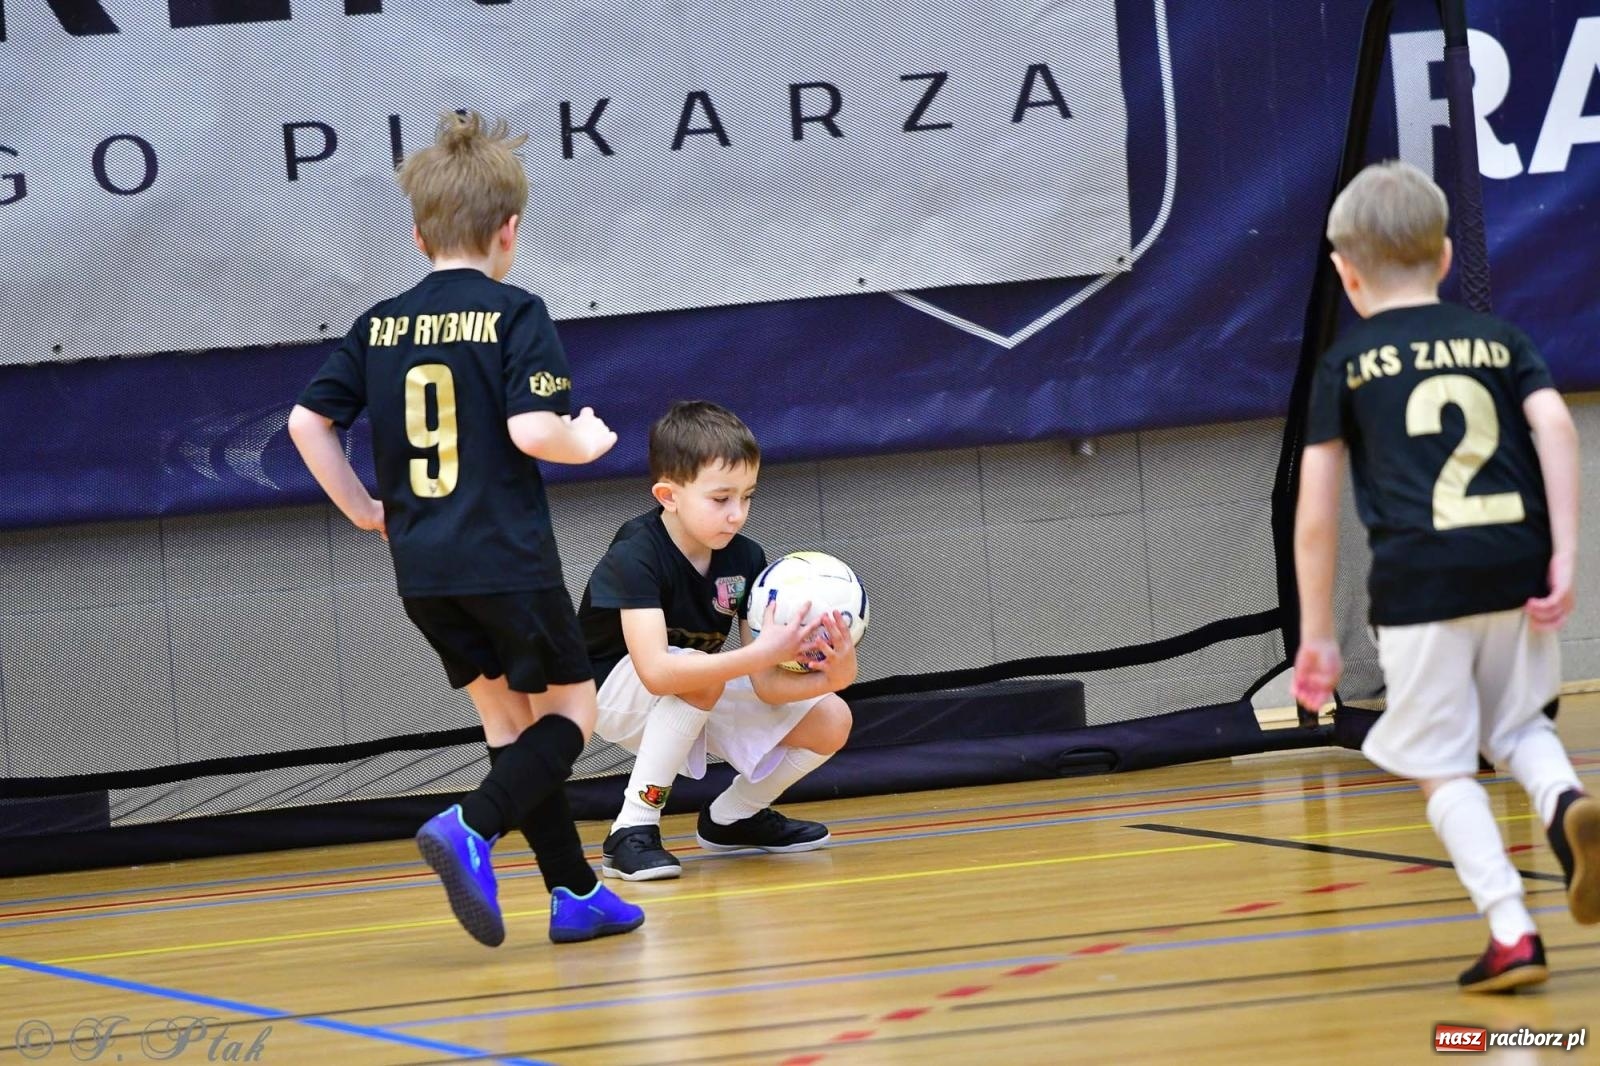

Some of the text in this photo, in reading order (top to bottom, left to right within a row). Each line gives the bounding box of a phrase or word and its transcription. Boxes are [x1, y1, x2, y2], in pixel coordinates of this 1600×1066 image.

[282, 63, 1073, 181] PIKARZA
[369, 311, 501, 346] RAP RYBNIK
[1410, 338, 1511, 370] ZAWAD
[405, 363, 459, 498] 9
[1405, 373, 1525, 531] 2
